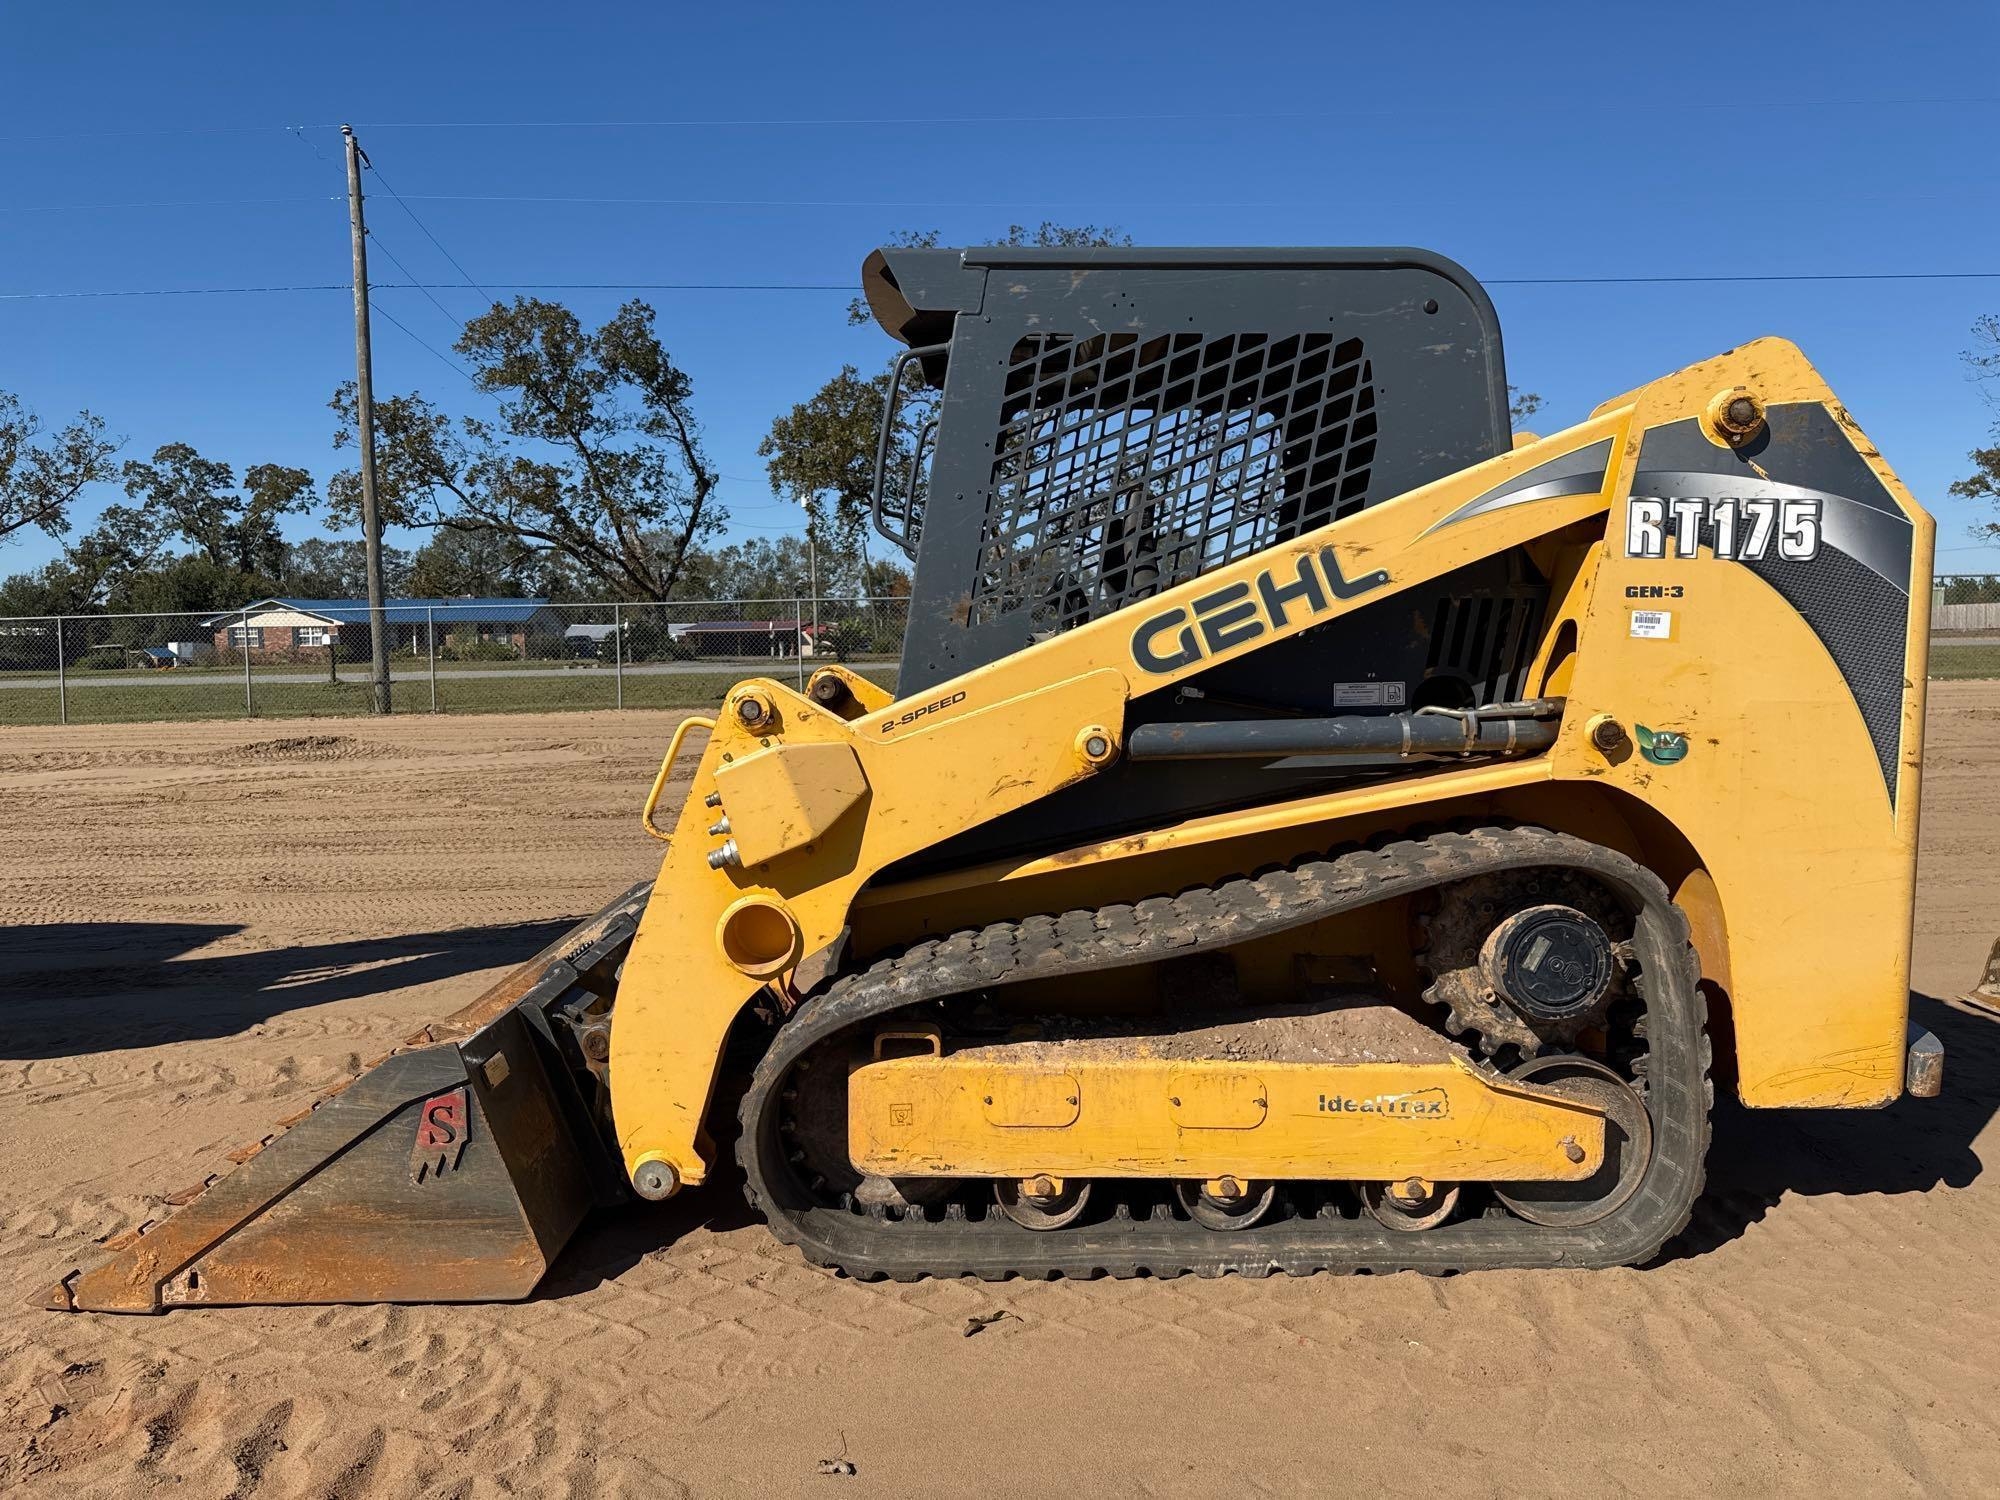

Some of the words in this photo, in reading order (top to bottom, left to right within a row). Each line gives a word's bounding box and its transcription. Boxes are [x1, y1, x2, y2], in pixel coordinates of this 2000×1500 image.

[1625, 496, 1823, 561] RT175
[1130, 544, 1389, 674] GEHL
[1625, 586, 1684, 598] GEN:3
[882, 691, 967, 733] 2-SPEED
[1319, 1094, 1442, 1113] IdealTrax
[428, 1105, 457, 1145] S
